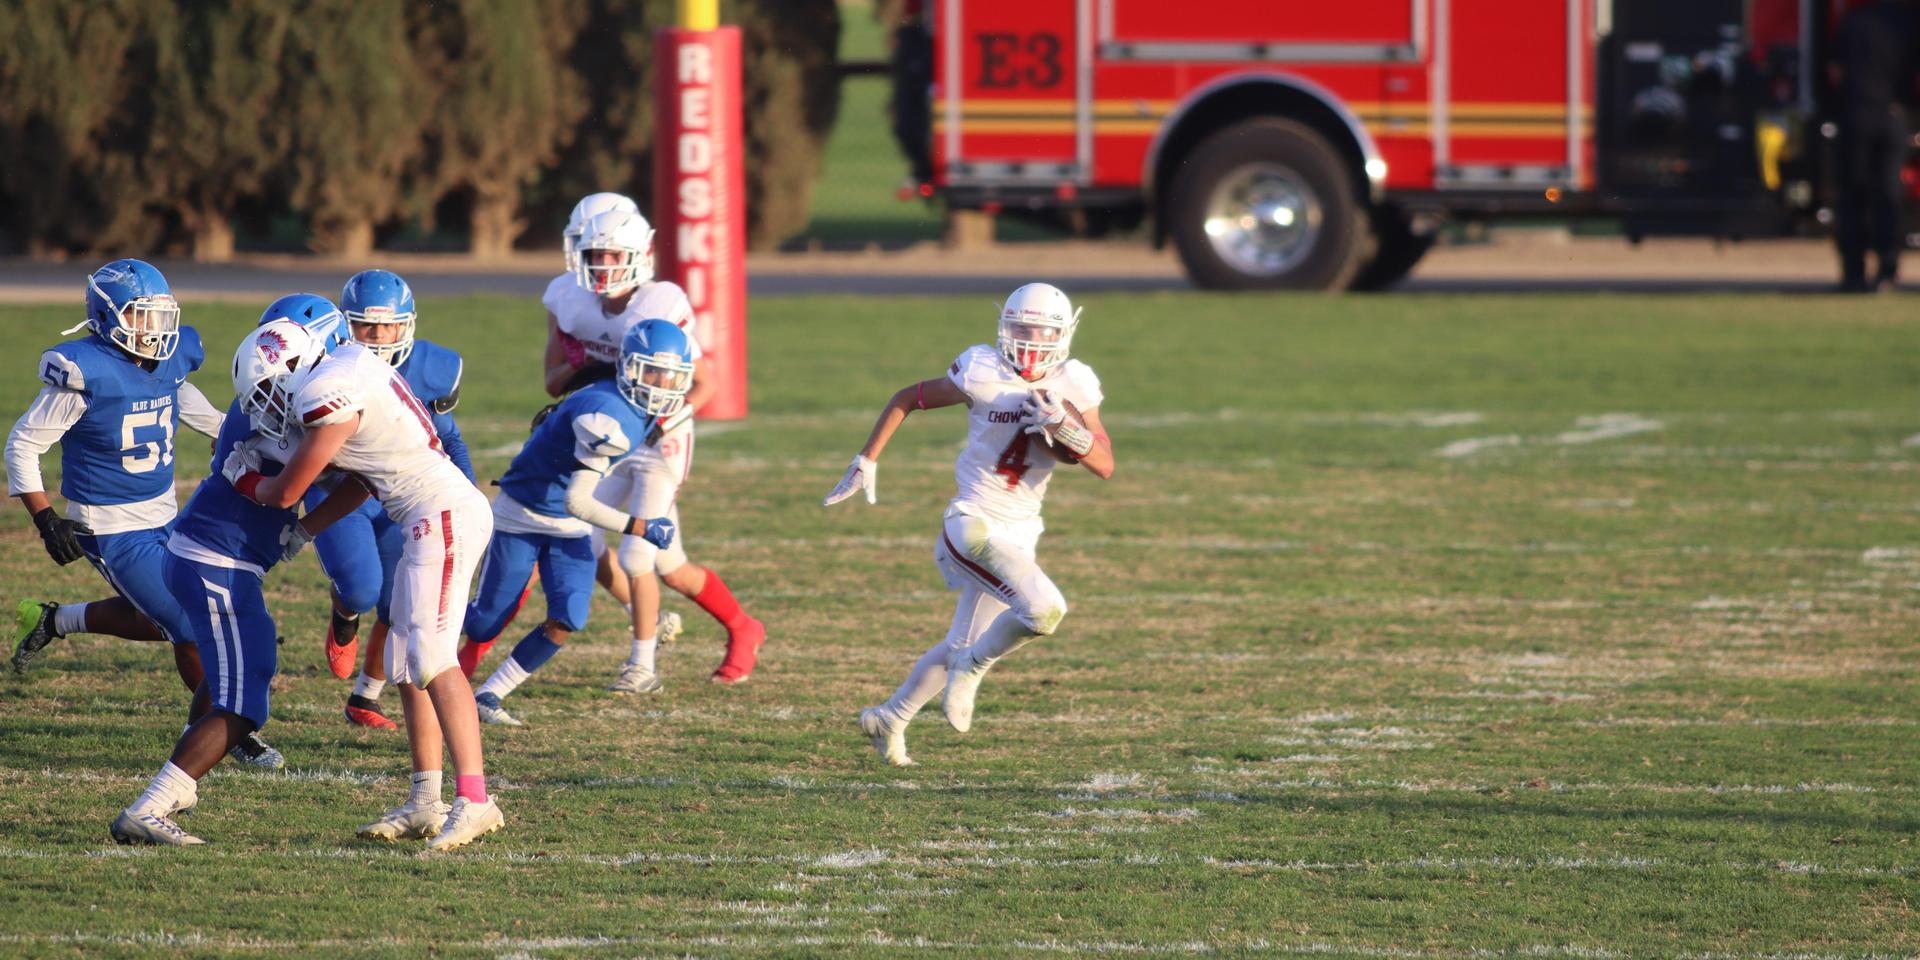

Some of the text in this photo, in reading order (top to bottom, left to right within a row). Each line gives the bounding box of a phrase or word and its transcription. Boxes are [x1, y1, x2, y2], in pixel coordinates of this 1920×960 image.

[977, 33, 1063, 88] E3
[43, 361, 70, 388] 51
[132, 395, 172, 412] BLUE RAIDERS
[988, 410, 1027, 424] CHOW
[121, 405, 173, 474] 51
[994, 424, 1031, 492] 4
